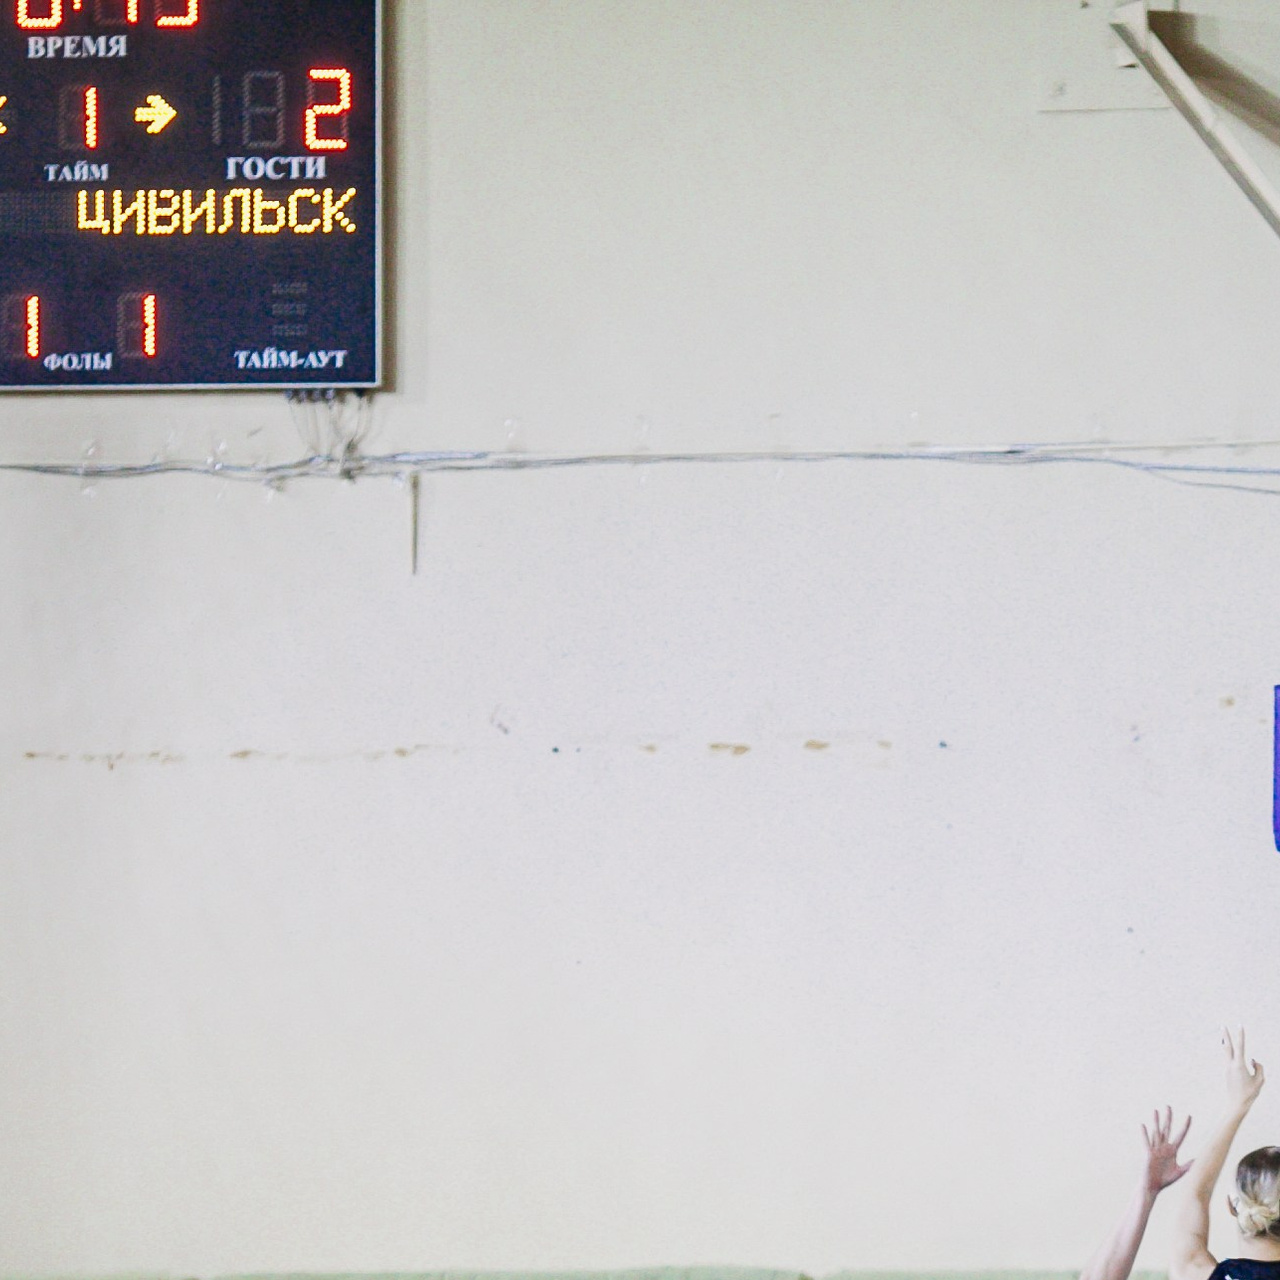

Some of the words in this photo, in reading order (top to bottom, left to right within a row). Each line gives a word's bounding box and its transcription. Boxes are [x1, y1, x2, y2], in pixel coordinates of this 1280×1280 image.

[27, 35, 128, 59] ВРЕМЯ
[84, 86, 98, 150] 1
[303, 67, 353, 150] 2
[44, 161, 109, 182] ТАЙМ
[225, 156, 328, 180] ГОСТИ
[77, 187, 357, 235] ЦИВИЛЬСК
[26, 294, 40, 358] 1
[143, 294, 157, 357] 1
[43, 352, 113, 371] ФОЛЫ
[234, 348, 348, 369] ТАЙМ-АУТ
